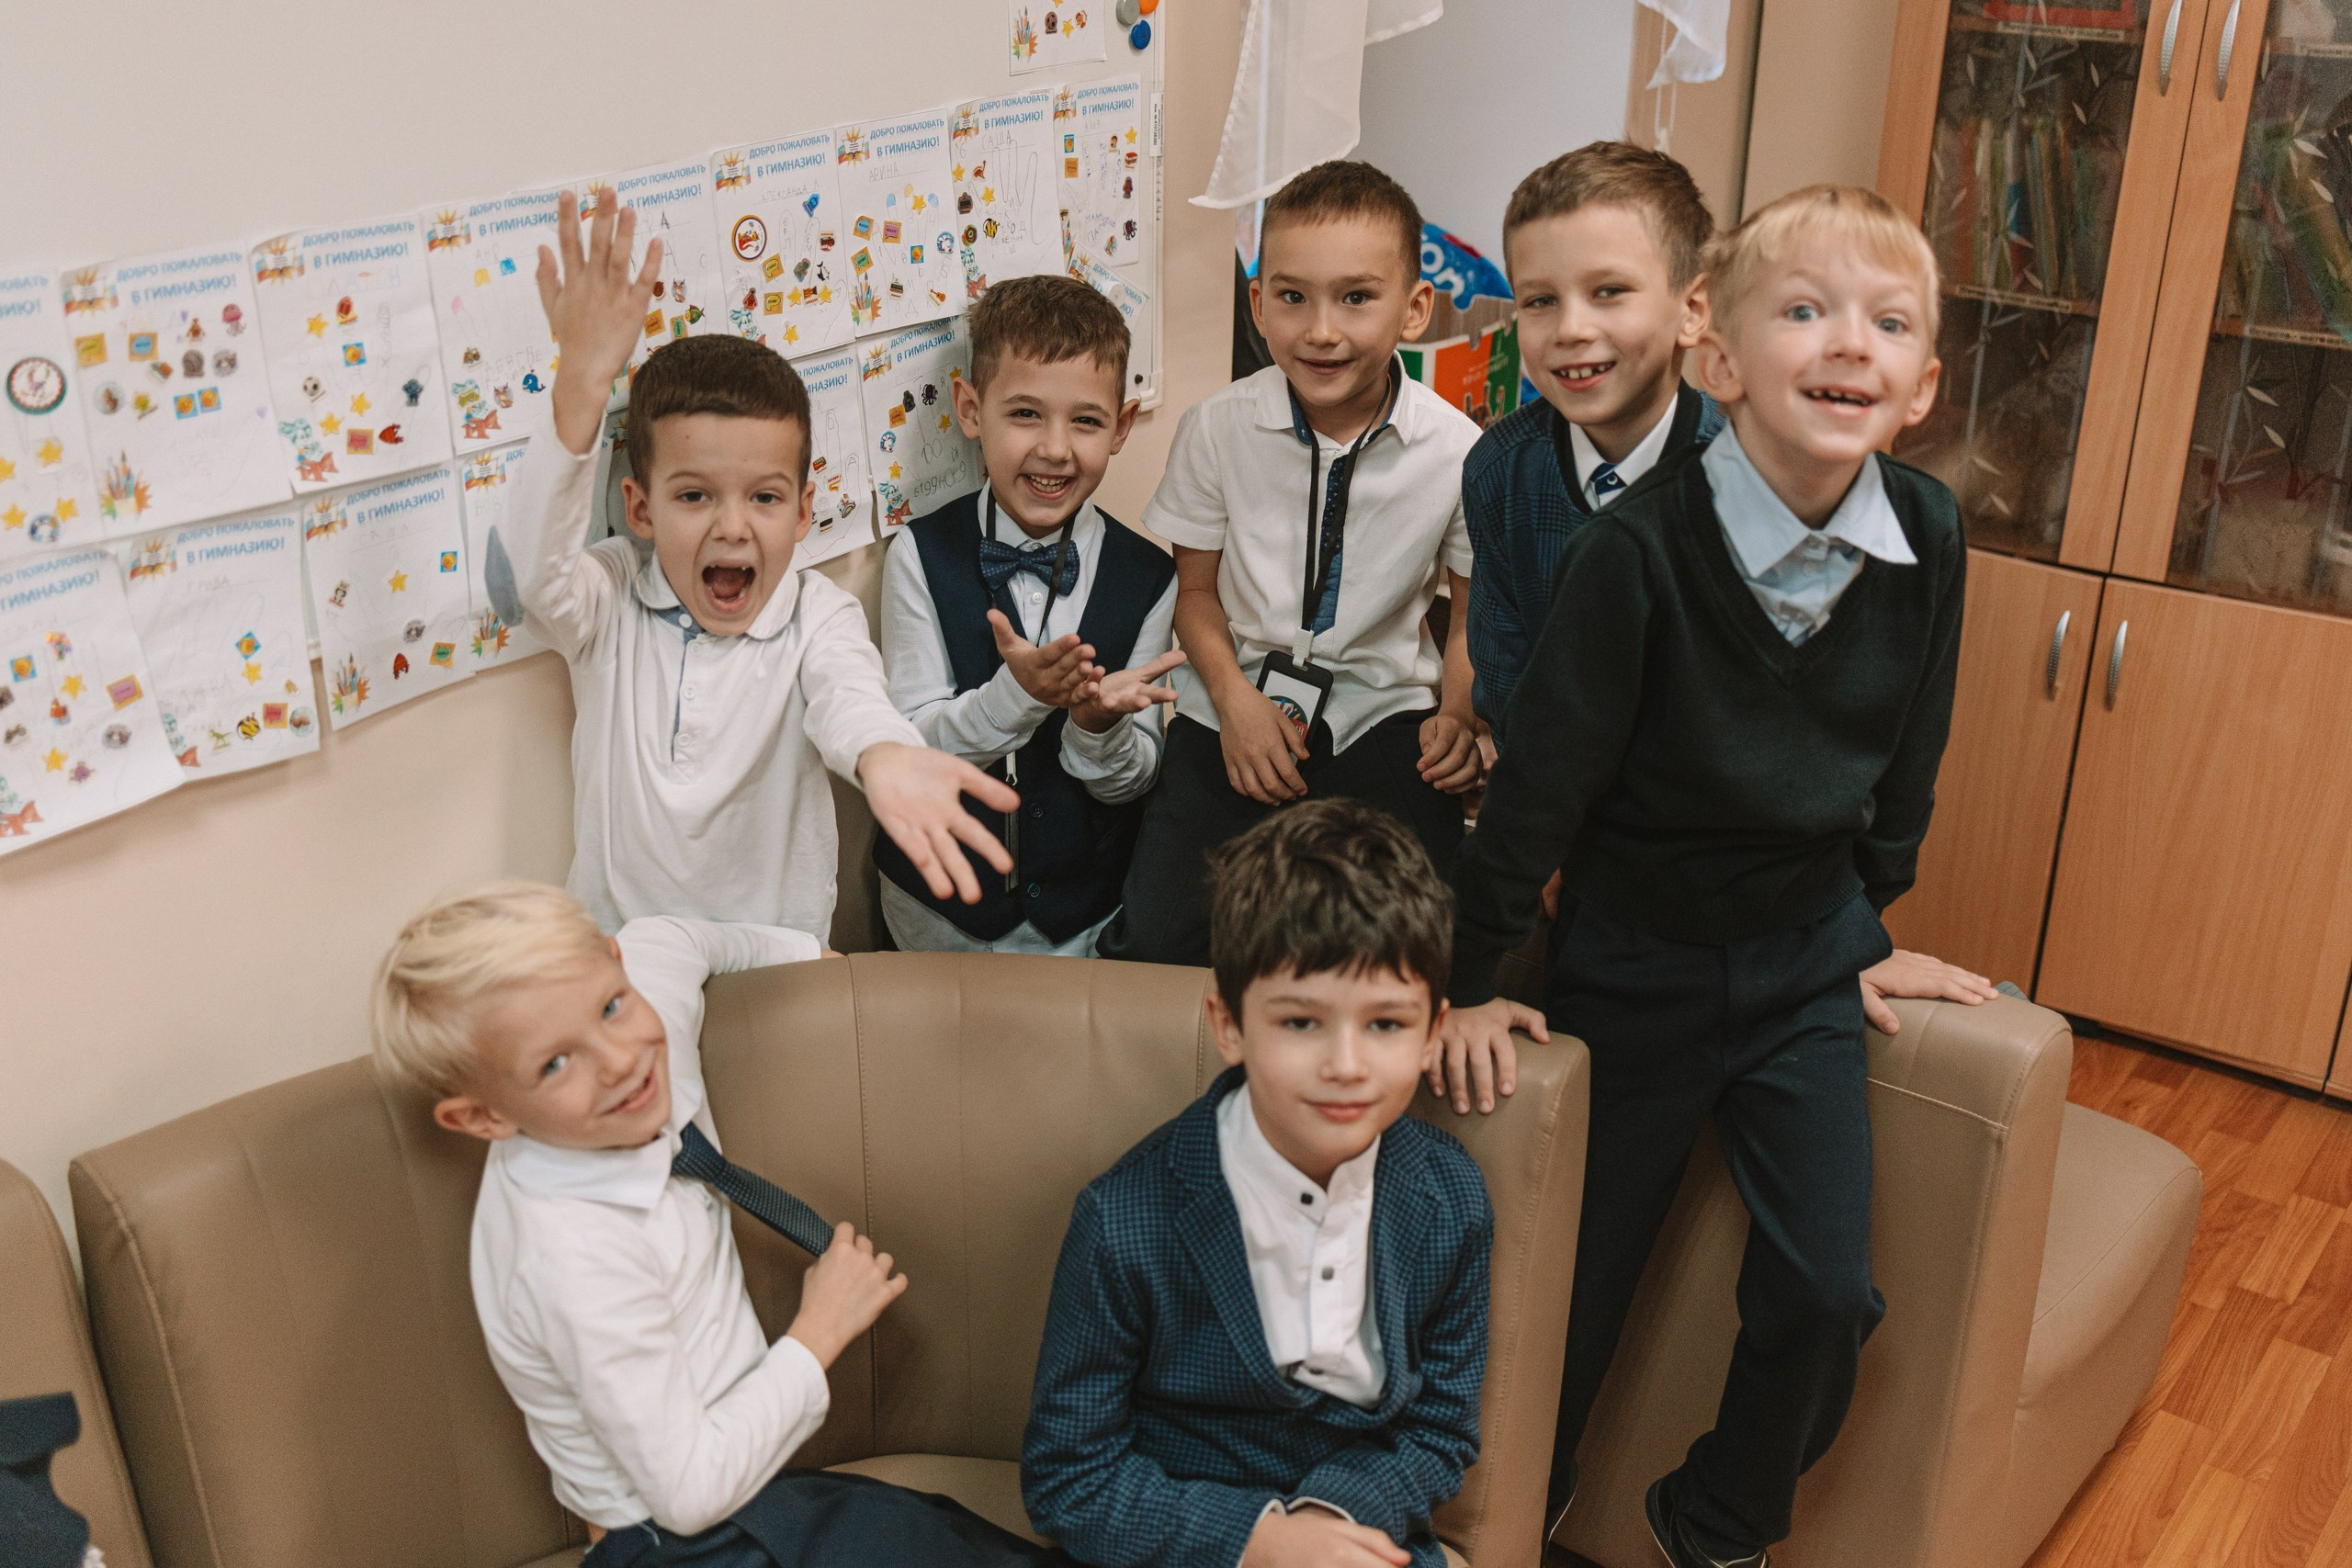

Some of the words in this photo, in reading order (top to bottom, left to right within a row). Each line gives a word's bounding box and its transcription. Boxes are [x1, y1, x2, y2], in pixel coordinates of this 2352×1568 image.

[1078, 87, 1098, 99] ДОБРО
[1099, 82, 1139, 95] ПОЖАЛОВАТЬ
[979, 100, 1001, 114] ДОБРО
[1001, 94, 1049, 107] ПОЖАЛОВАТЬ
[1082, 106, 1087, 116] В
[1089, 98, 1135, 115] ГИМНАЗИЮ!
[870, 127, 895, 141] ДОБРО
[896, 118, 944, 134] ПОЖАЛОВАТЬ
[984, 118, 989, 130] В
[991, 110, 1044, 129] ГИМНАЗИЮ!
[749, 144, 776, 160] ДОБРО
[777, 134, 831, 152] ПОЖАЛОВАТЬ
[877, 146, 883, 157] В
[885, 136, 940, 155] ГИМНАЗИЮ!
[757, 166, 763, 177] В
[766, 152, 826, 175] ГИМНАЗИЮ!
[869, 162, 899, 182] АРИНА
[617, 177, 648, 193] ДОБРО
[649, 164, 707, 185] ПОЖАЛОВАТЬ
[469, 200, 502, 218] ДОБРО
[503, 191, 560, 209] ПОЖАЛОВА
[628, 198, 635, 209] В
[637, 184, 702, 209] ГИМНАЗИЮ!
[302, 231, 339, 248] ДОБРО
[341, 221, 415, 241] ПОЖАЛОВАТЬ
[479, 225, 487, 236] В
[490, 210, 560, 234] ГИМНАЗИЮ
[117, 263, 159, 284] ДОБРО
[161, 252, 243, 276] ПОЖАЛОВАТЬ
[313, 255, 322, 269] В
[325, 243, 409, 266] ГИМНАЗИЮ!
[131, 290, 141, 304] В
[143, 275, 237, 301] ГИМНАЗИЮ!
[890, 332, 913, 349] ДОБРО
[914, 314, 959, 338] ПОЖАЛОВАТЬ
[897, 353, 902, 362] В
[904, 330, 956, 360] ГИМНАЗИЮ!
[803, 356, 854, 378] ПОЖАЛОВАТЬ
[505, 448, 526, 463] ДОБ
[345, 487, 380, 506] ДОБРО
[382, 468, 451, 494] ПОЖАЛОВАТЬ
[357, 512, 366, 525] В
[368, 488, 446, 520] ГИМНАЗИЮ!
[177, 526, 214, 544] ДОБРО
[215, 517, 295, 536] ПОЖАЛОВАТЬ
[187, 550, 195, 564] В
[198, 537, 285, 562] ГИМНАЗИЮ!
[16, 549, 108, 581] ПОЖАЛОВАТЬ
